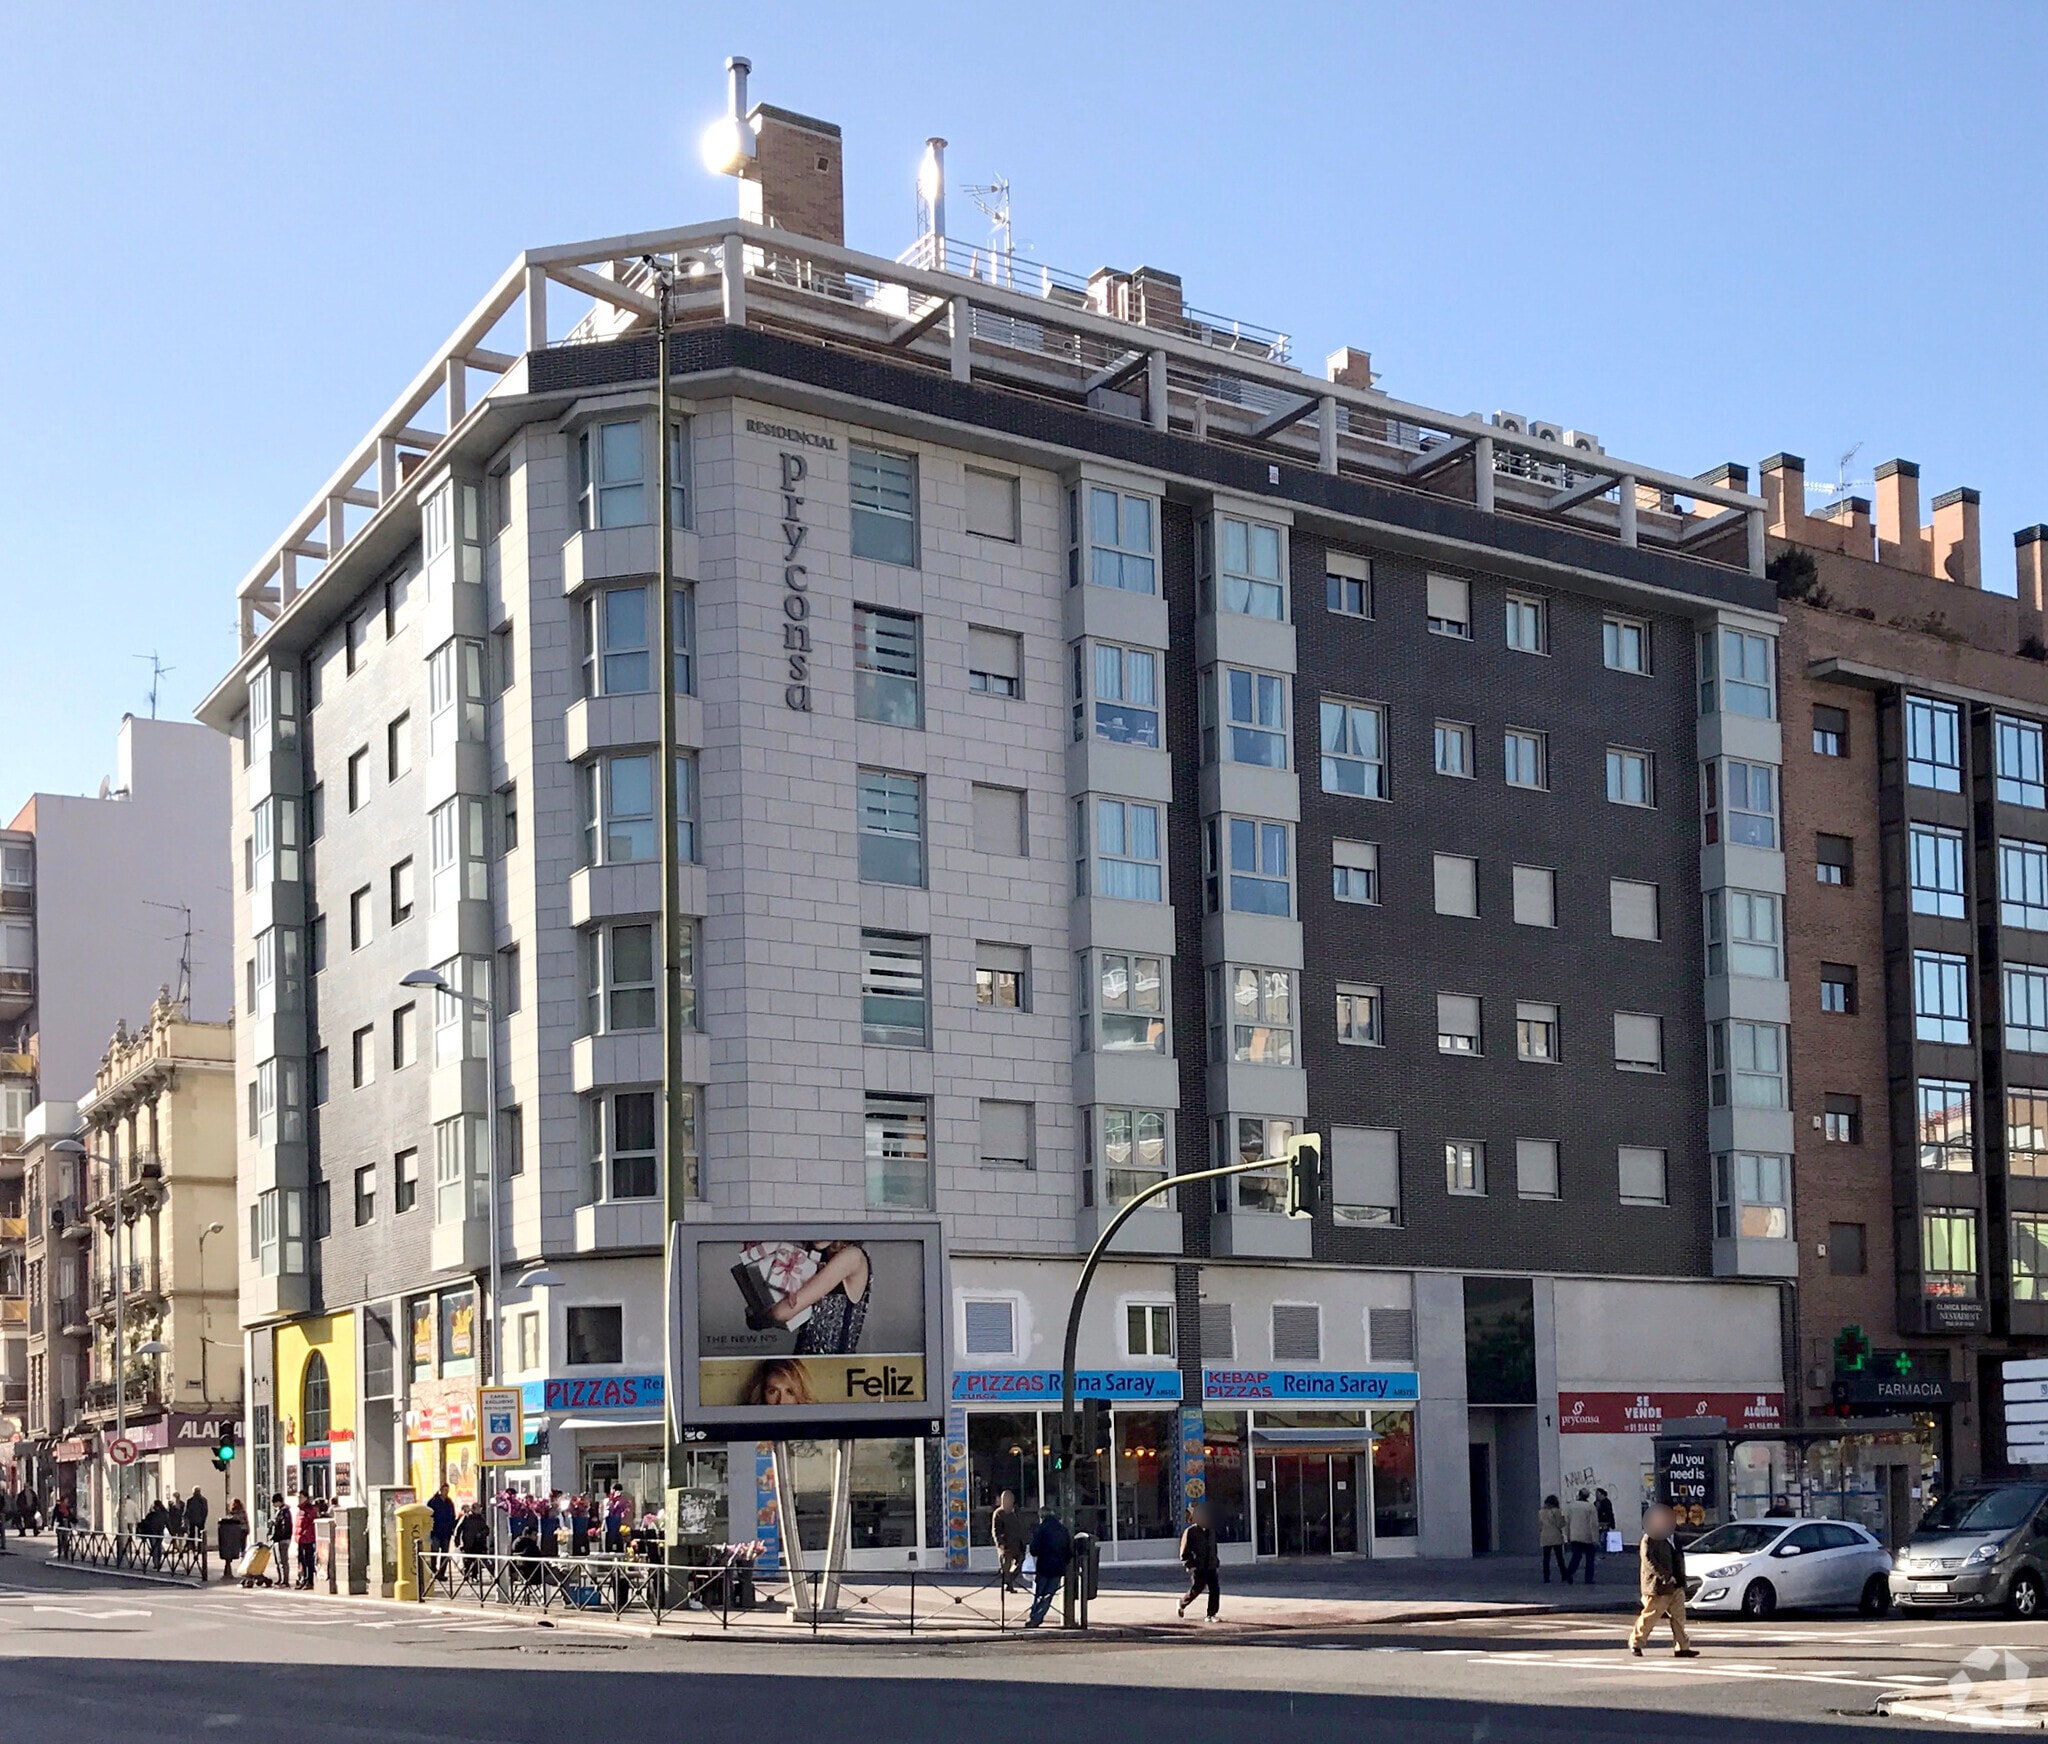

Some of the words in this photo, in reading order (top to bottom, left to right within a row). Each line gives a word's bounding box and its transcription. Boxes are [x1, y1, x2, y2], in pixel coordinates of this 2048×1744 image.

[746, 419, 838, 451] RESIDENCIAL
[779, 452, 812, 711] pryconsa
[730, 1335, 757, 1343] NEW
[846, 1366, 914, 1397] Feliz
[967, 1375, 1044, 1391] PIZZAS
[1048, 1373, 1101, 1391] Rina
[1105, 1373, 1155, 1396] Saray
[1209, 1372, 1268, 1384] KEBAP
[547, 1379, 637, 1407] PIZZAS
[1207, 1386, 1273, 1398] PIZZAS
[1283, 1375, 1335, 1392] Reina
[1339, 1375, 1389, 1398] Saray
[1878, 1383, 1943, 1396] FARMACIA
[1636, 1395, 1650, 1407] SE
[1756, 1396, 1766, 1406] SE
[1624, 1406, 1662, 1419] VENDE
[1743, 1406, 1780, 1417] ALQUILA
[1561, 1415, 1600, 1427] pryconsa
[177, 1420, 220, 1439] ALAI
[1670, 1453, 1684, 1465] All
[1685, 1455, 1705, 1468] you
[1670, 1468, 1694, 1479] need
[1695, 1468, 1705, 1479] is
